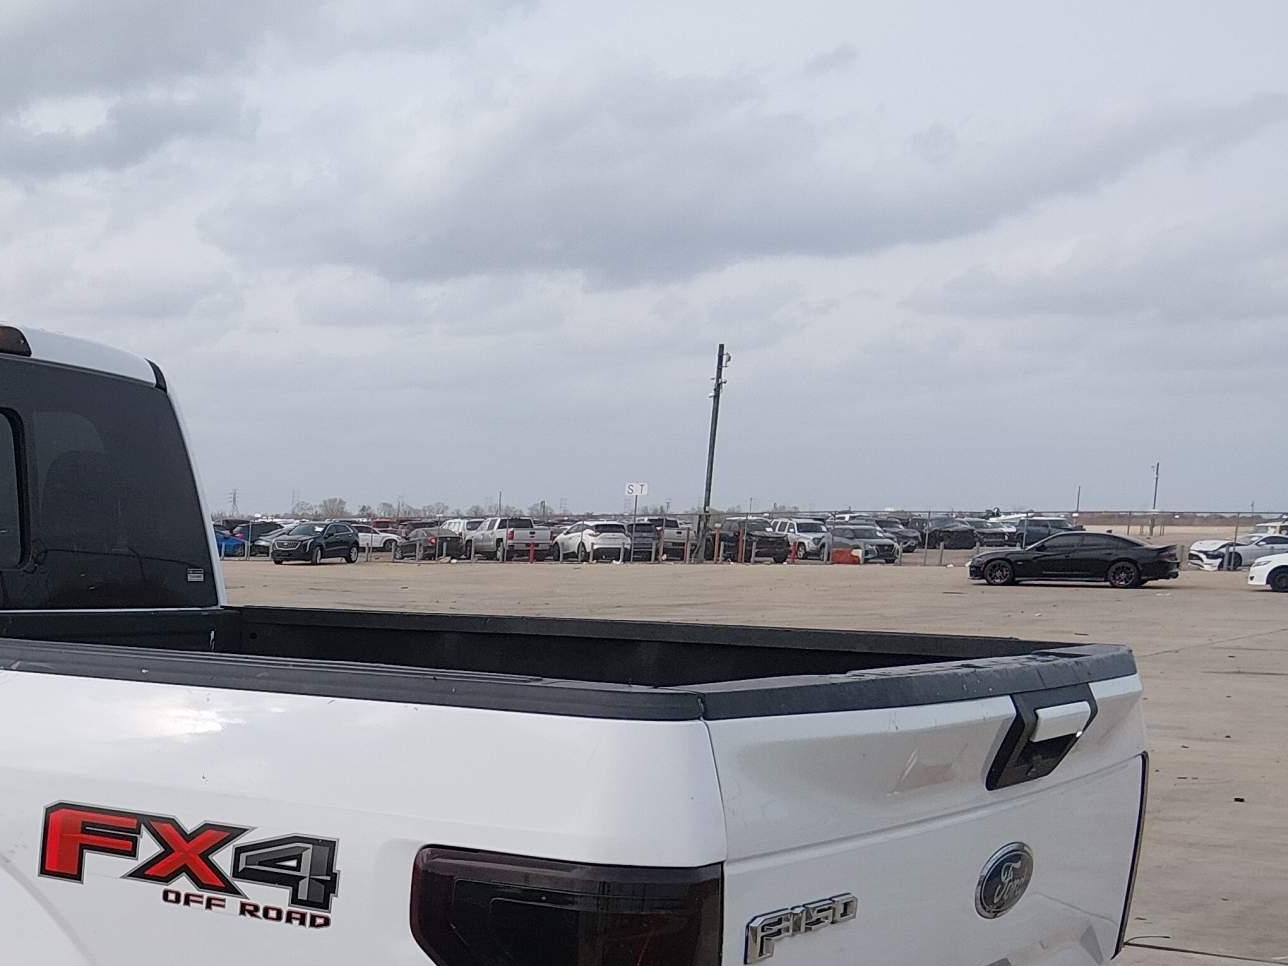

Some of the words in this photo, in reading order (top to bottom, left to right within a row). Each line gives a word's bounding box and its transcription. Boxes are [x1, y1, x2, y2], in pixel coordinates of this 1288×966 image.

[39, 801, 340, 914] FX4
[162, 888, 227, 912] OFF
[238, 901, 332, 929] ROAD
